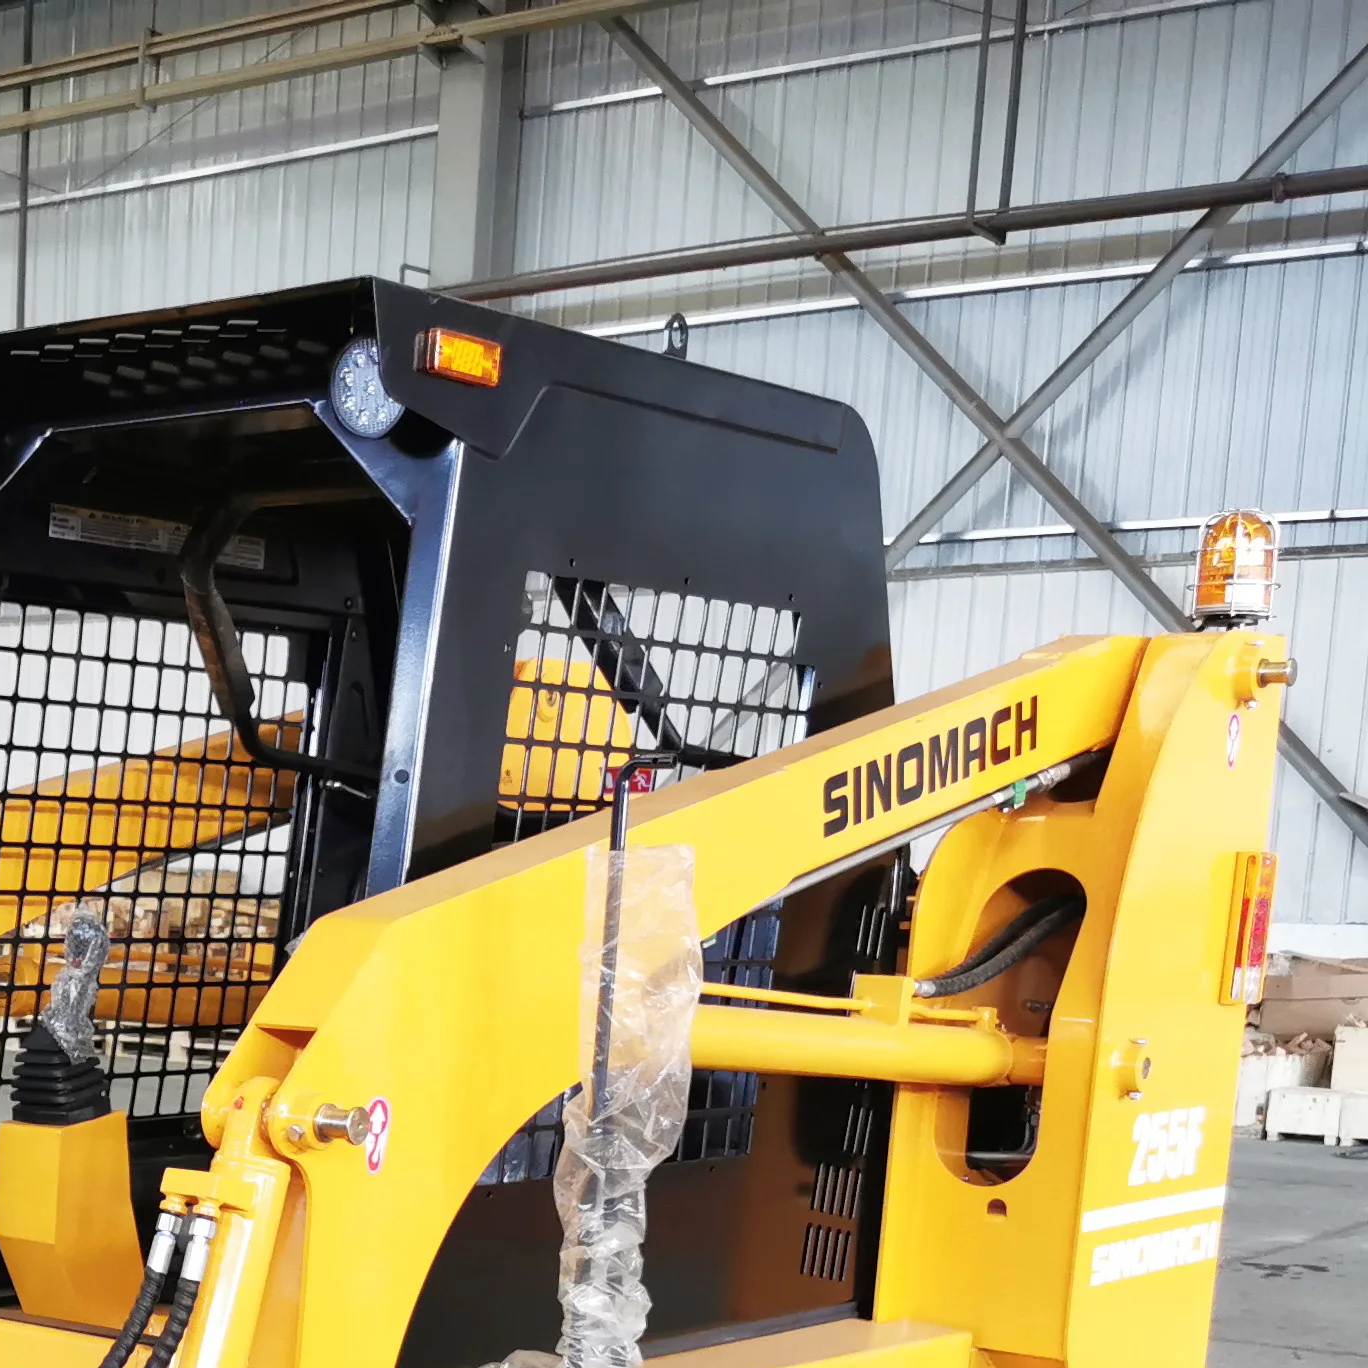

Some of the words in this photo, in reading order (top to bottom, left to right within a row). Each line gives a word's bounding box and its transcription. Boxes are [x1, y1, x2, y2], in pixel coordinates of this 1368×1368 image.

[823, 695, 1038, 838] SINOMACH
[1128, 1106, 1206, 1187] 255F
[1089, 1220, 1220, 1287] SINOMACH
